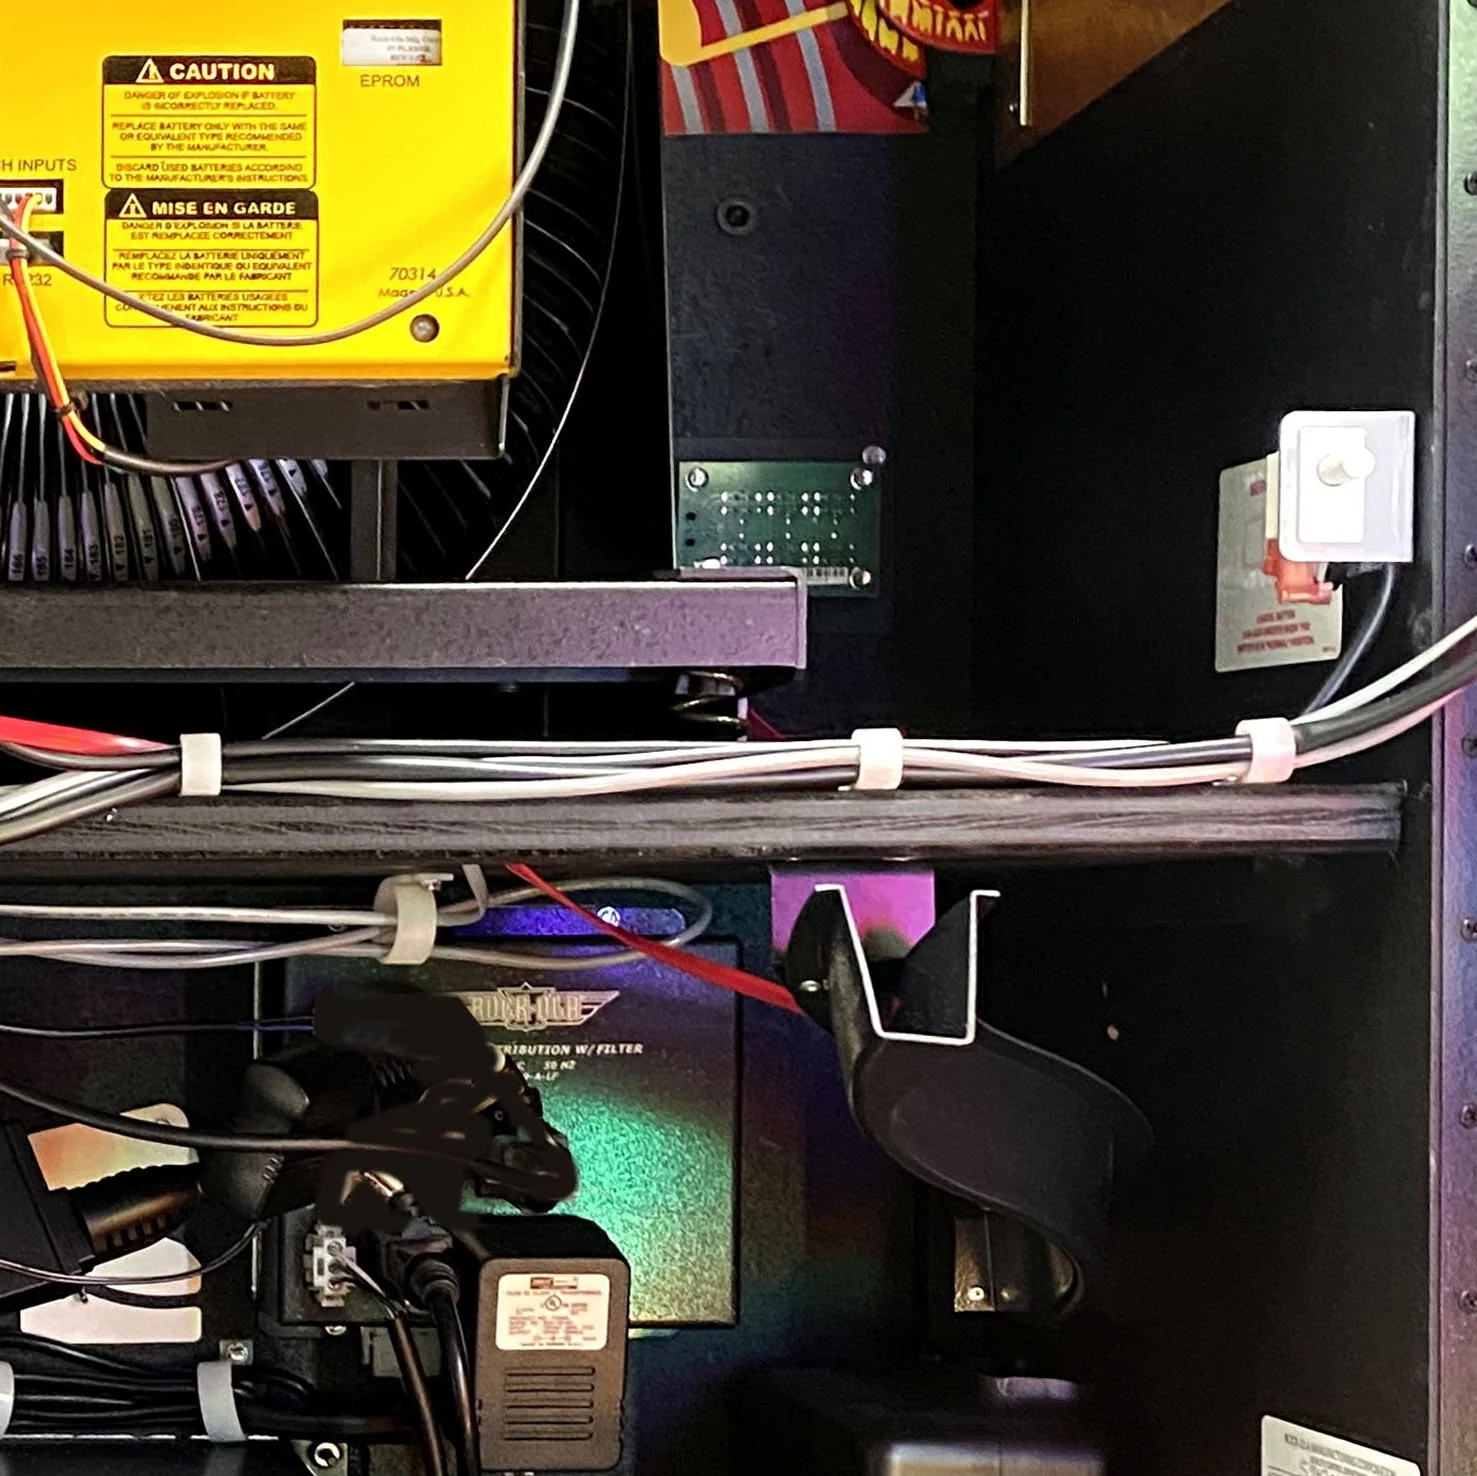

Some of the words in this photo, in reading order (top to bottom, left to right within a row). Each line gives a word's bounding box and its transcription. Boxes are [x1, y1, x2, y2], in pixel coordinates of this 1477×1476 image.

[169, 63, 275, 81] CAUTION
[360, 74, 420, 88] EPROM
[124, 91, 166, 100] DANGER
[168, 91, 181, 100] OF
[183, 91, 239, 100] EXPLOSION
[252, 91, 295, 100] BATTERY
[154, 101, 222, 110] INCORRECTLY
[112, 122, 157, 131] REPLACE
[159, 122, 202, 131] BATTERY
[204, 122, 229, 131] ONLY
[232, 122, 256, 131] WITH
[259, 122, 277, 131] THE
[280, 122, 307, 131] SAME
[120, 132, 134, 141] OR
[136, 132, 197, 141] EQUIVALENT
[199, 132, 223, 141] TYPE
[225, 132, 302, 141] RECOMMENDED
[150, 143, 163, 152] BY
[166, 143, 184, 152] THE
[17, 158, 77, 172] INPUTS
[116, 163, 158, 172] DISCARD
[160, 163, 188, 172] USED
[190, 163, 242, 172] BATTERIES
[244, 163, 303, 172] ACCORDING
[109, 174, 122, 183] TO
[125, 174, 143, 183] THE
[152, 201, 198, 215] MISE
[203, 201, 228, 215] EN
[233, 201, 296, 215] GARDE
[388, 267, 436, 281] 70314
[2, 273, 53, 287] R232
[497, 1044, 571, 1056] TRIBUTION
